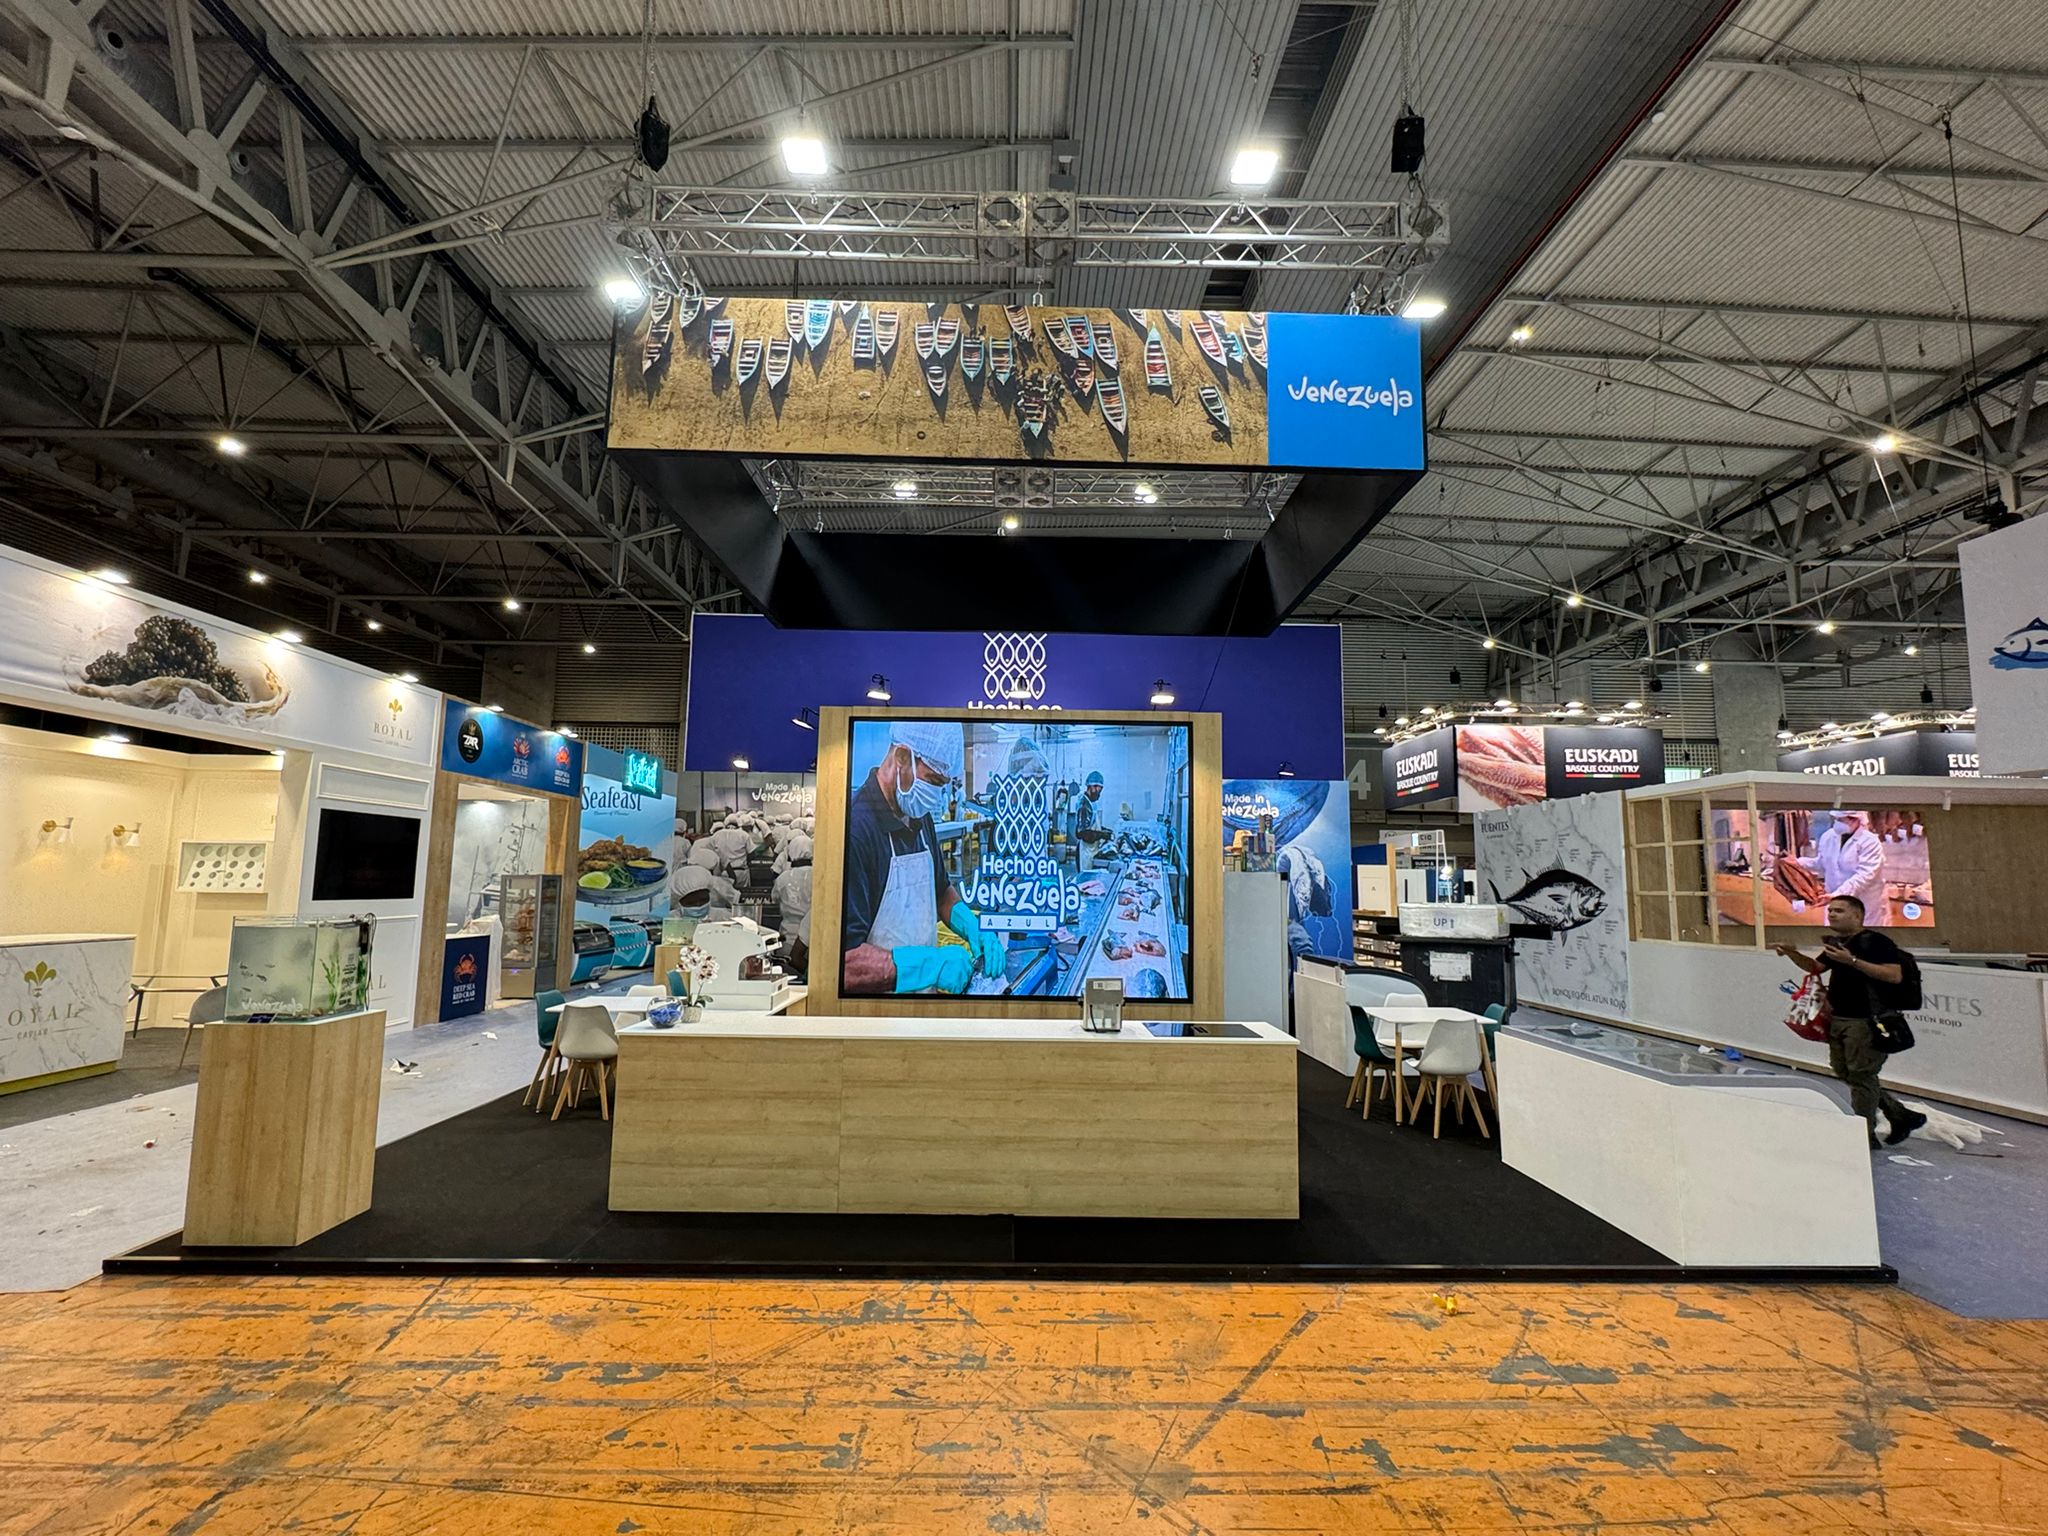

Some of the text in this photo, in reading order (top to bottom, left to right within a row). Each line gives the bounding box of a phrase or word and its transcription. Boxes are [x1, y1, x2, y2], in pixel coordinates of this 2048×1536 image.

[373, 722, 413, 741] ROYAL
[462, 734, 479, 750] ZAR
[1564, 748, 1638, 763] EUSKADI
[512, 764, 529, 775] CRAB
[1396, 749, 1438, 778] EUSKADI
[1565, 764, 1640, 773] BASQUE COUNTRY
[1348, 759, 1371, 800] 4
[765, 783, 788, 792] Made
[581, 786, 642, 812] Seafeast
[1224, 794, 1251, 804] Made
[1481, 821, 1510, 833] FUENTES
[982, 854, 1057, 876] Hecho en
[1433, 918, 1448, 927] UP
[1923, 993, 1982, 1017] NTES
[8, 1003, 81, 1027] OYAL
[1939, 1018, 1962, 1028] ROJO
[17, 1028, 48, 1039] CAVIAR
